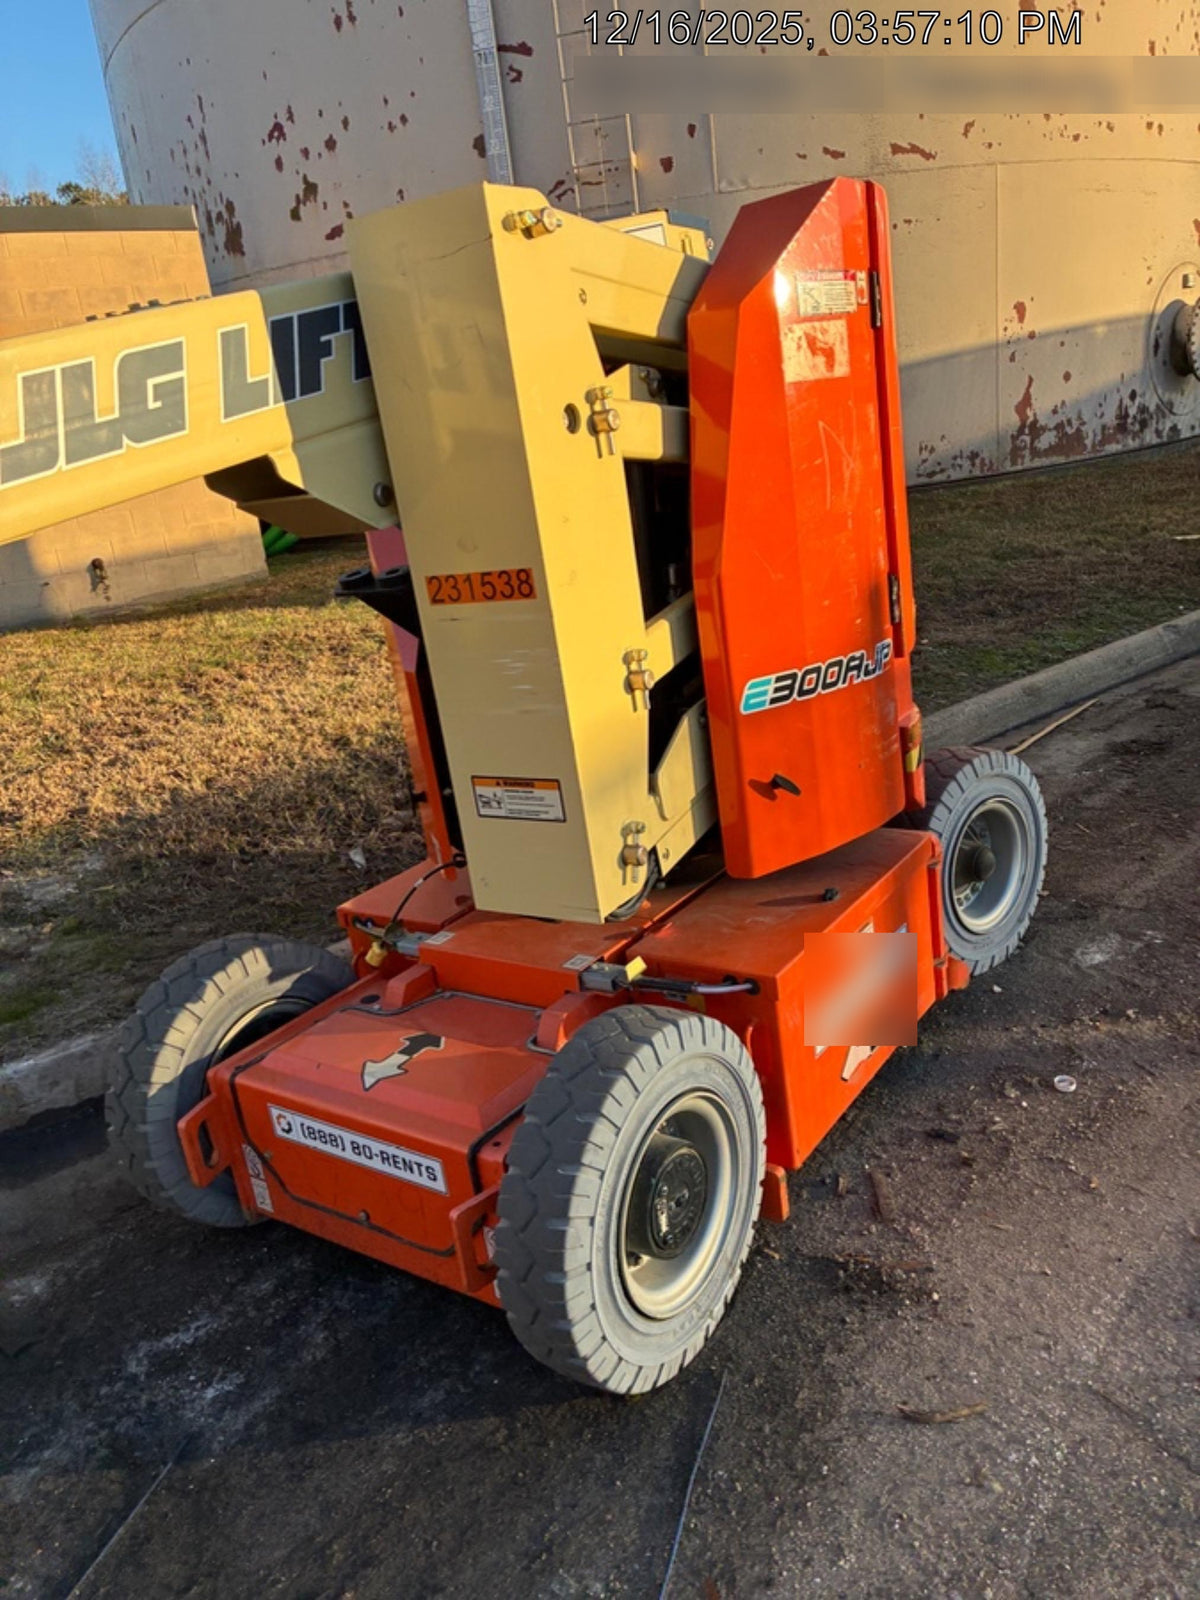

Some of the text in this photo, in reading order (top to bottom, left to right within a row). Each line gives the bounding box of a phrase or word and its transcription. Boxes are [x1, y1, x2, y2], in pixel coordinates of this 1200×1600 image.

[0, 336, 190, 489] JLG
[428, 568, 534, 604] 231538
[741, 639, 892, 715] E300AJP
[299, 1121, 438, 1182] (888) 80-RENTS
